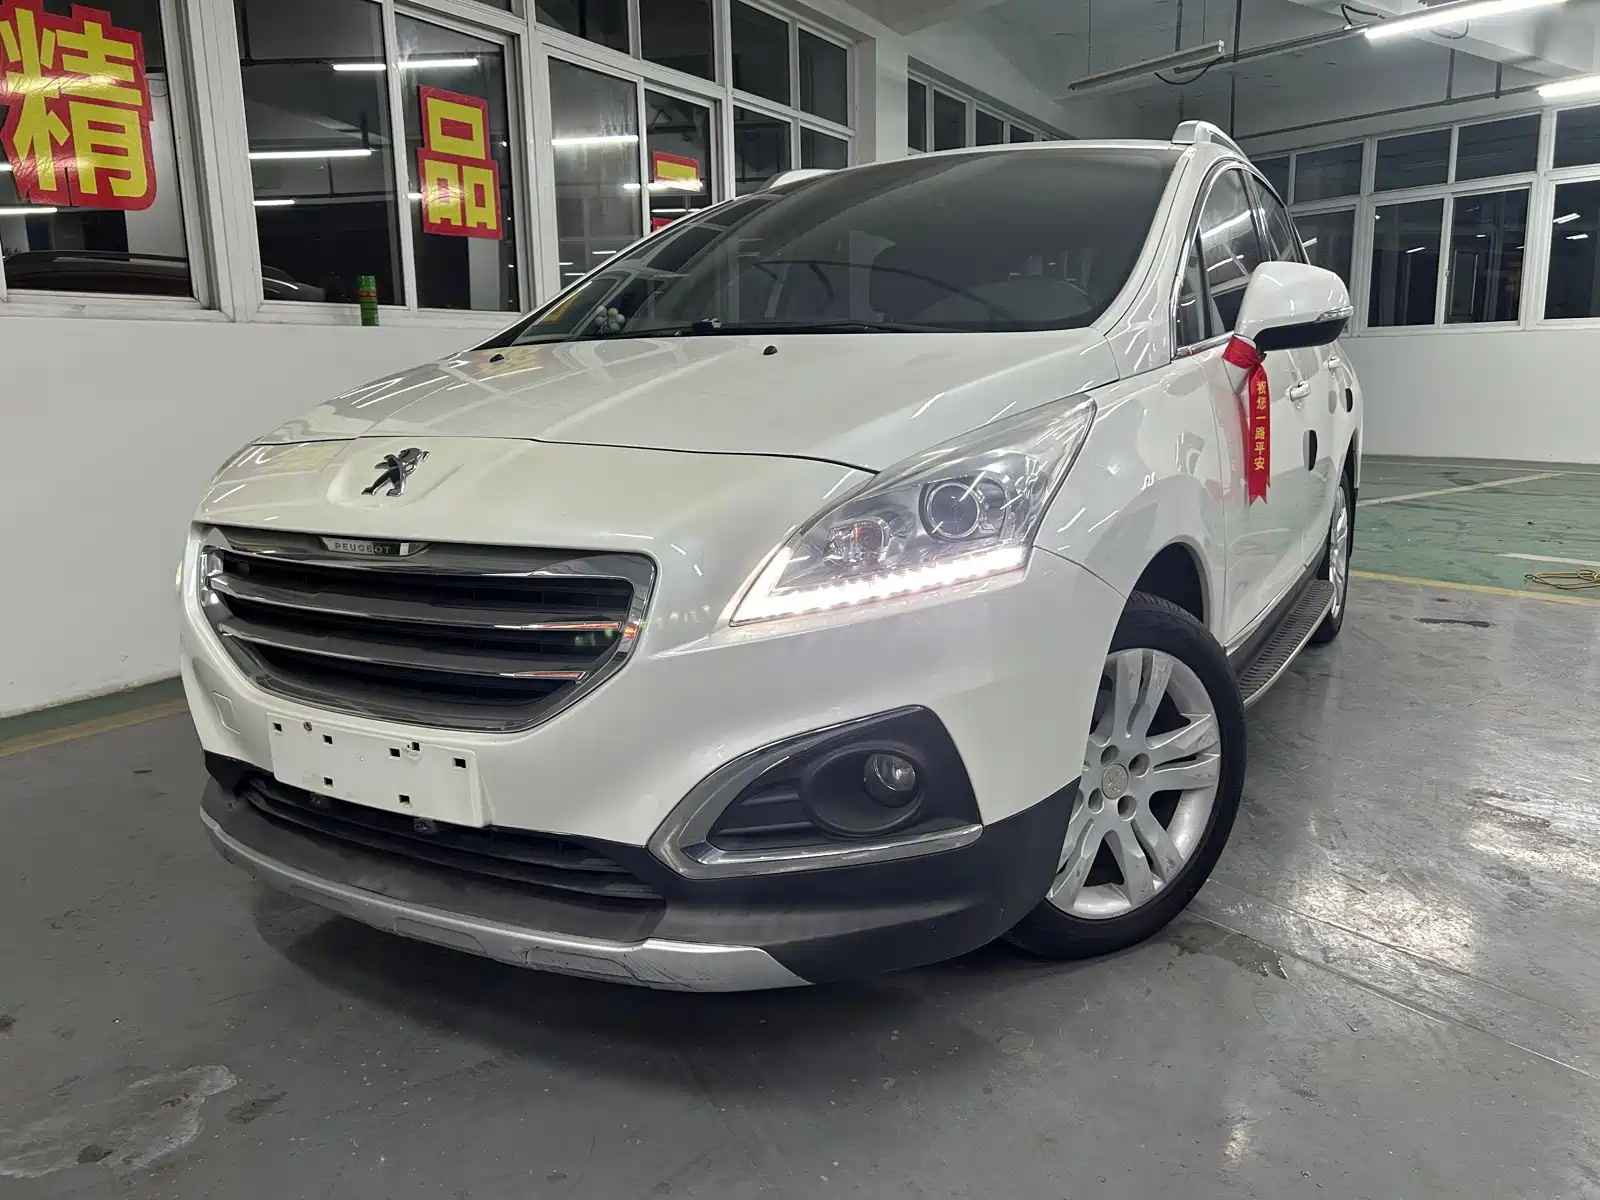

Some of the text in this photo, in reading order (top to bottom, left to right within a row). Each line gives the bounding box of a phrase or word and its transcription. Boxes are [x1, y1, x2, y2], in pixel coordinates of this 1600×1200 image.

[0, 7, 148, 197] 精
[424, 97, 497, 230] 品
[1254, 380, 1267, 471] 祝您一路平安
[334, 541, 391, 554] PEUGEOT
